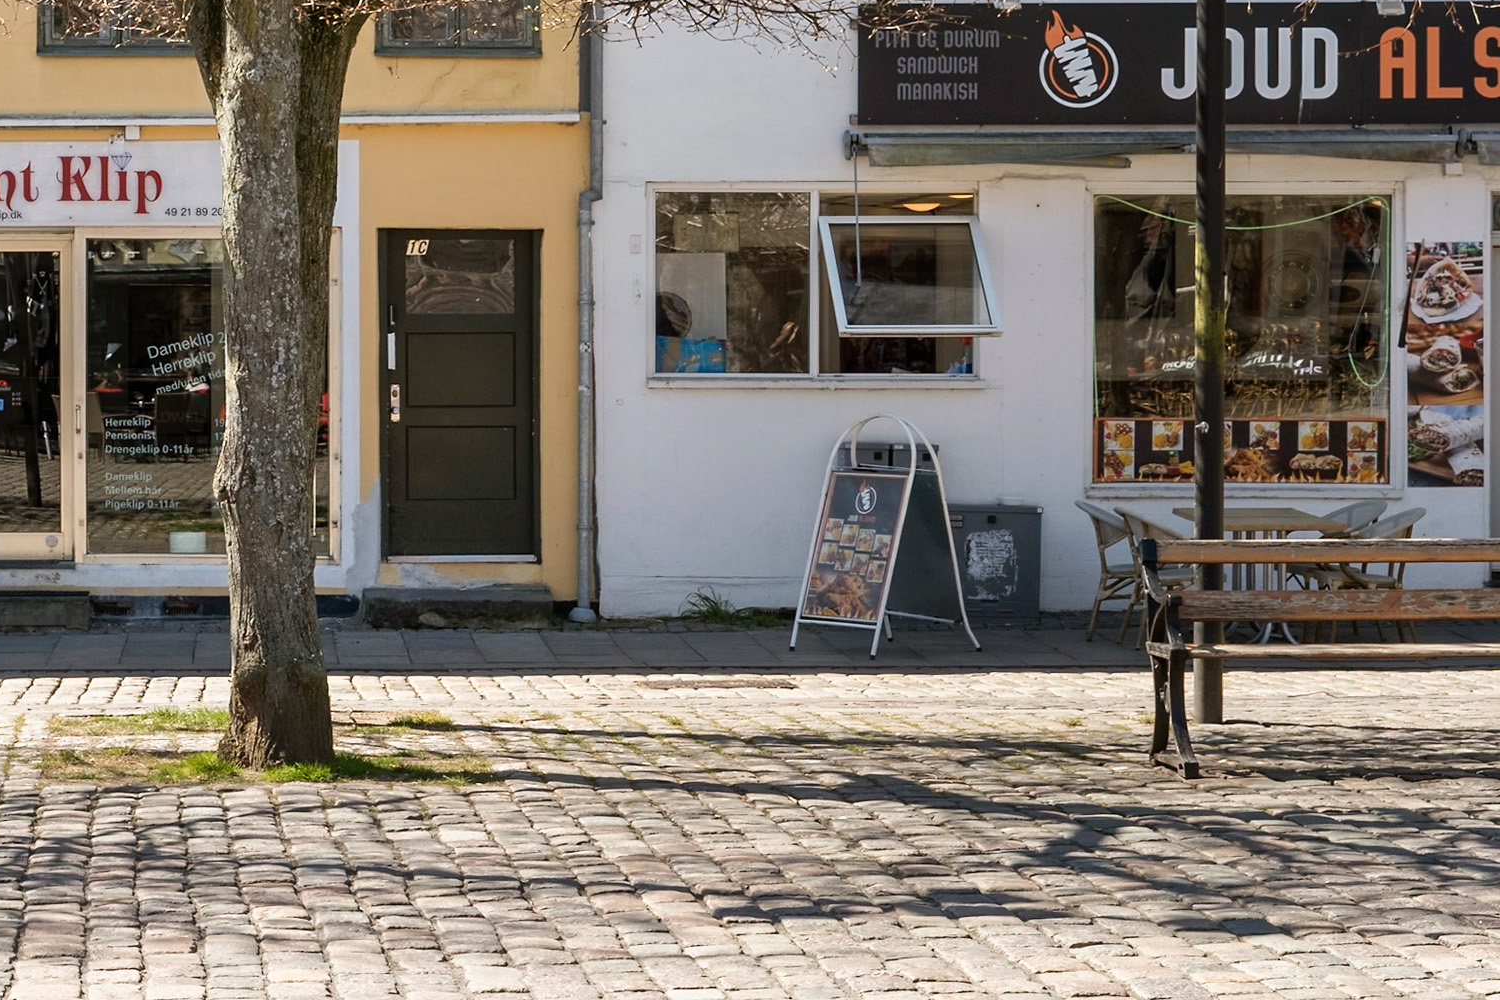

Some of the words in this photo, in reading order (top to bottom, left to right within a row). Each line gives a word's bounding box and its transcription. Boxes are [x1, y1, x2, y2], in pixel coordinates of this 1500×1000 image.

[875, 30, 910, 48] PITA
[917, 30, 937, 48] OG
[944, 29, 1000, 48] DURUM
[897, 56, 978, 74] SANDWICH
[897, 82, 978, 100] MANAKISH
[56, 155, 163, 214] Klip
[164, 207, 178, 217] 49
[180, 207, 192, 217] 21
[195, 207, 209, 217] 89
[146, 332, 214, 359] Dameklip
[151, 350, 216, 376] Herreklip
[156, 374, 207, 395] med/uden
[105, 417, 151, 428] Herreklip
[105, 431, 156, 440] Pensionist
[105, 444, 160, 456] Drengeklip
[105, 472, 152, 482] Dameklip
[105, 499, 145, 510] Pigeklip
